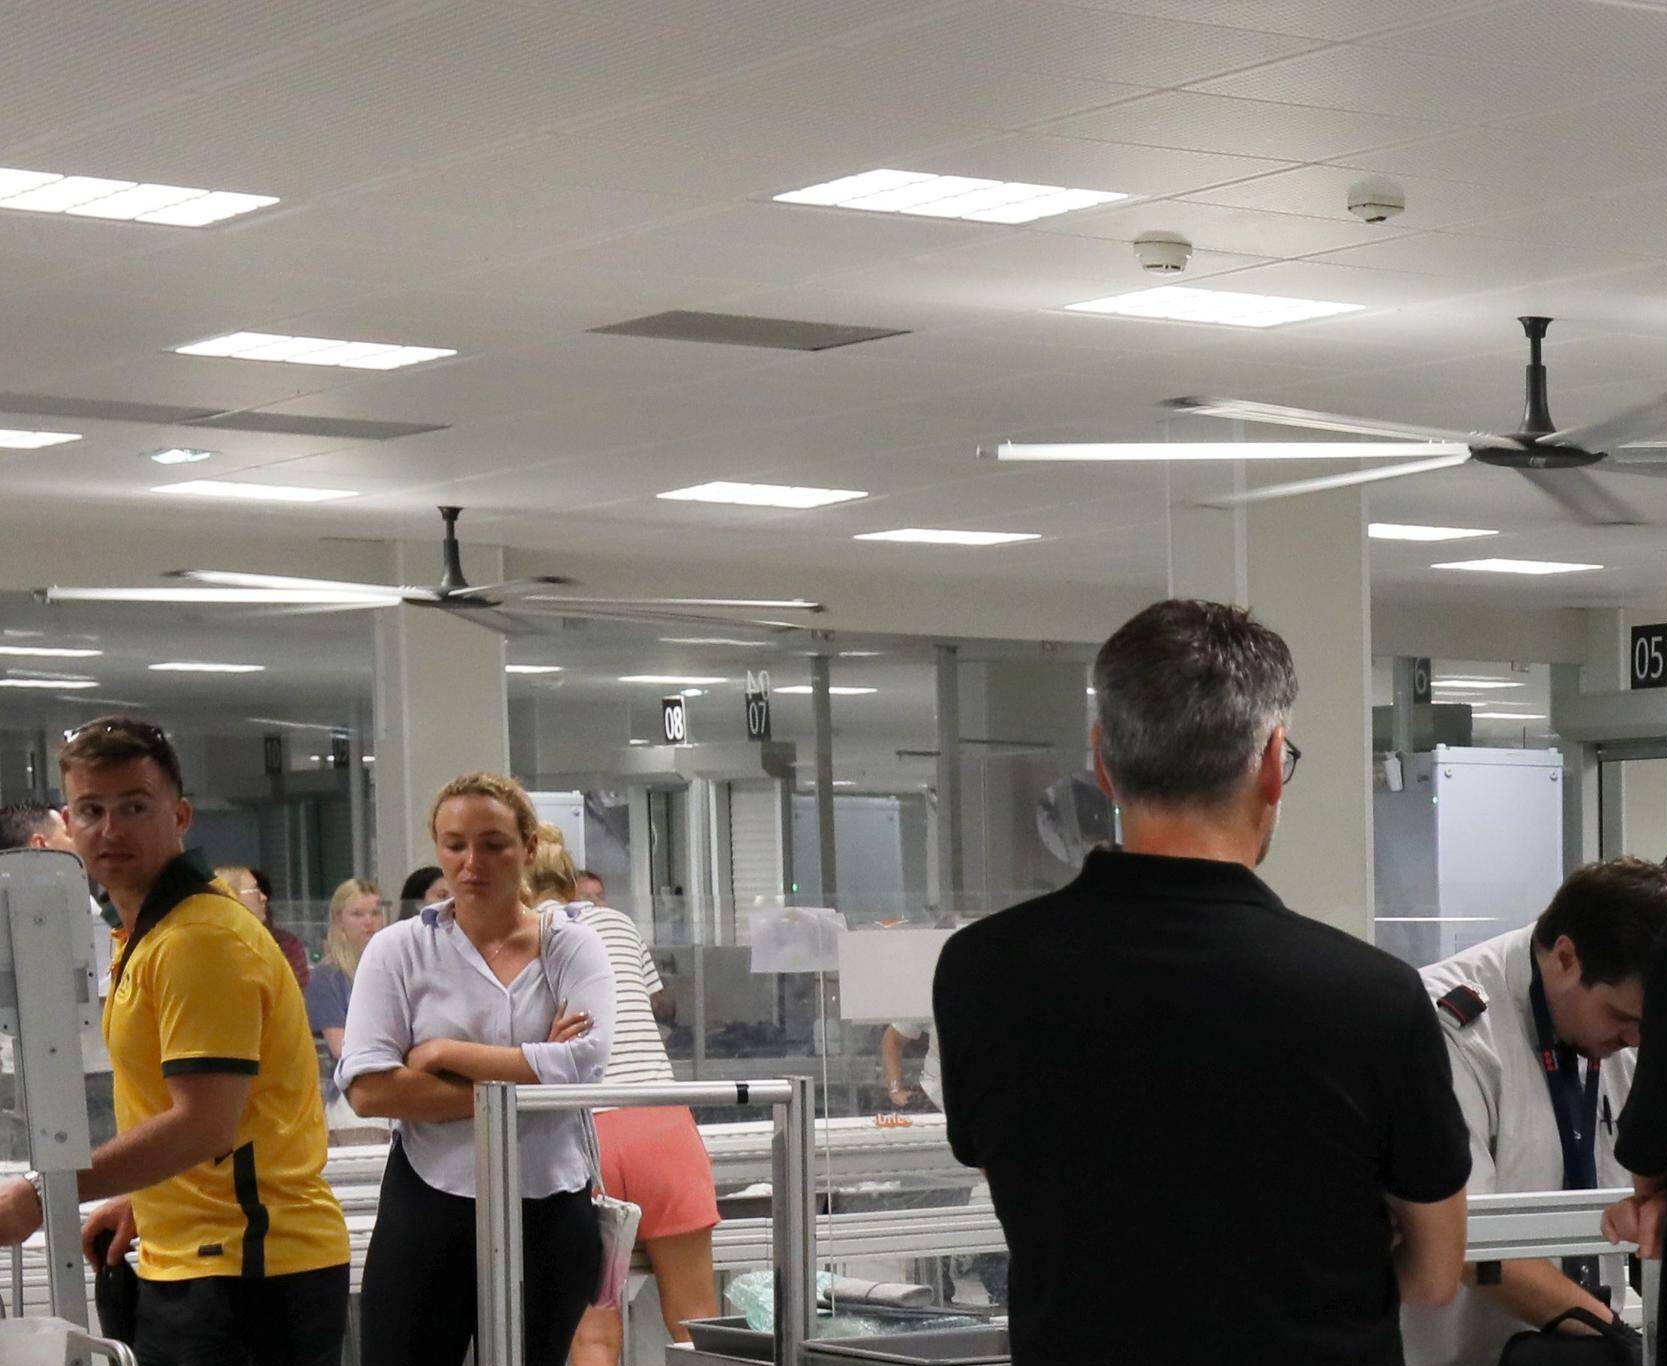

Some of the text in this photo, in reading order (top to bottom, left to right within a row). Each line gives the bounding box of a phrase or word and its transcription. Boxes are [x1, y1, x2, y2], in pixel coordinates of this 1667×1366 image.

[1414, 656, 1428, 695] 6
[1635, 636, 1663, 680] 05
[664, 705, 684, 741] 08
[749, 702, 767, 735] 07
